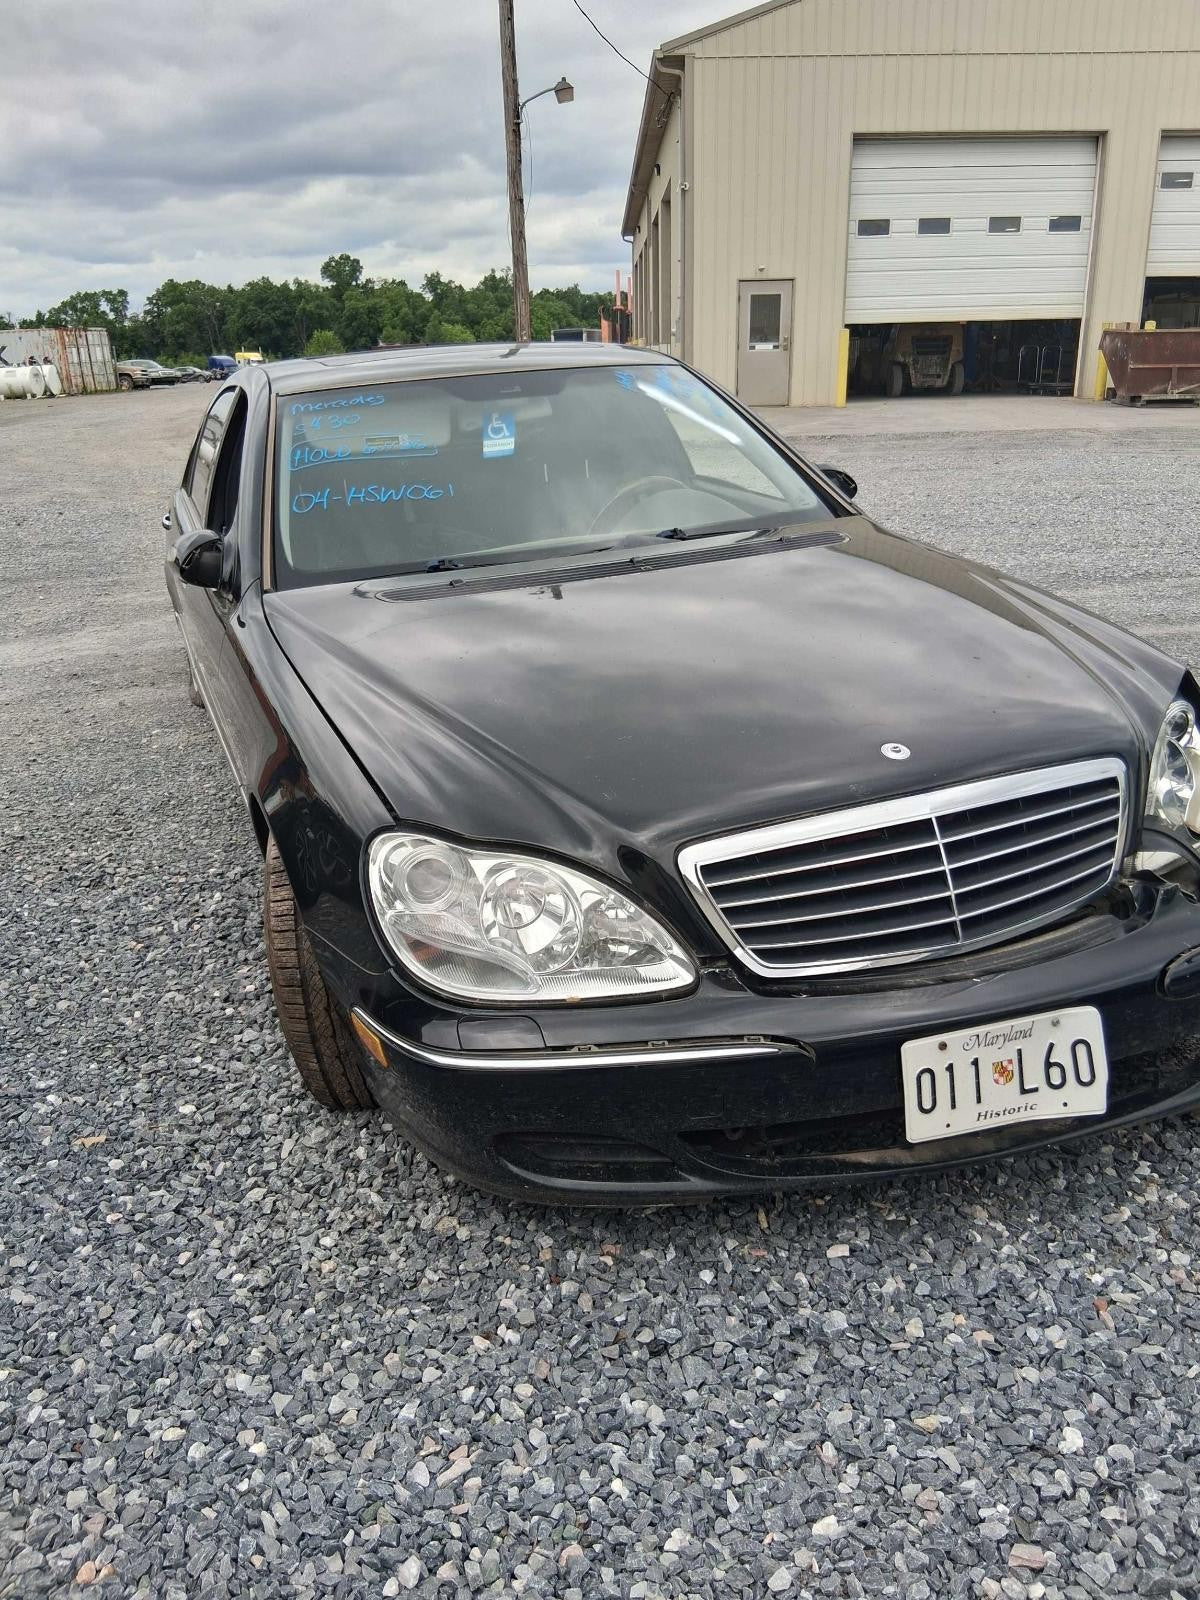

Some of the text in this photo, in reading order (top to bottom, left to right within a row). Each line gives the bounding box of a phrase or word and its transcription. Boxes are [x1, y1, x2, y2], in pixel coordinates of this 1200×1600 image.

[291, 445, 352, 467] HOLD
[962, 1020, 1036, 1052] Maryland
[916, 1038, 1097, 1115] 011 L60
[976, 1102, 1039, 1122] Historic
